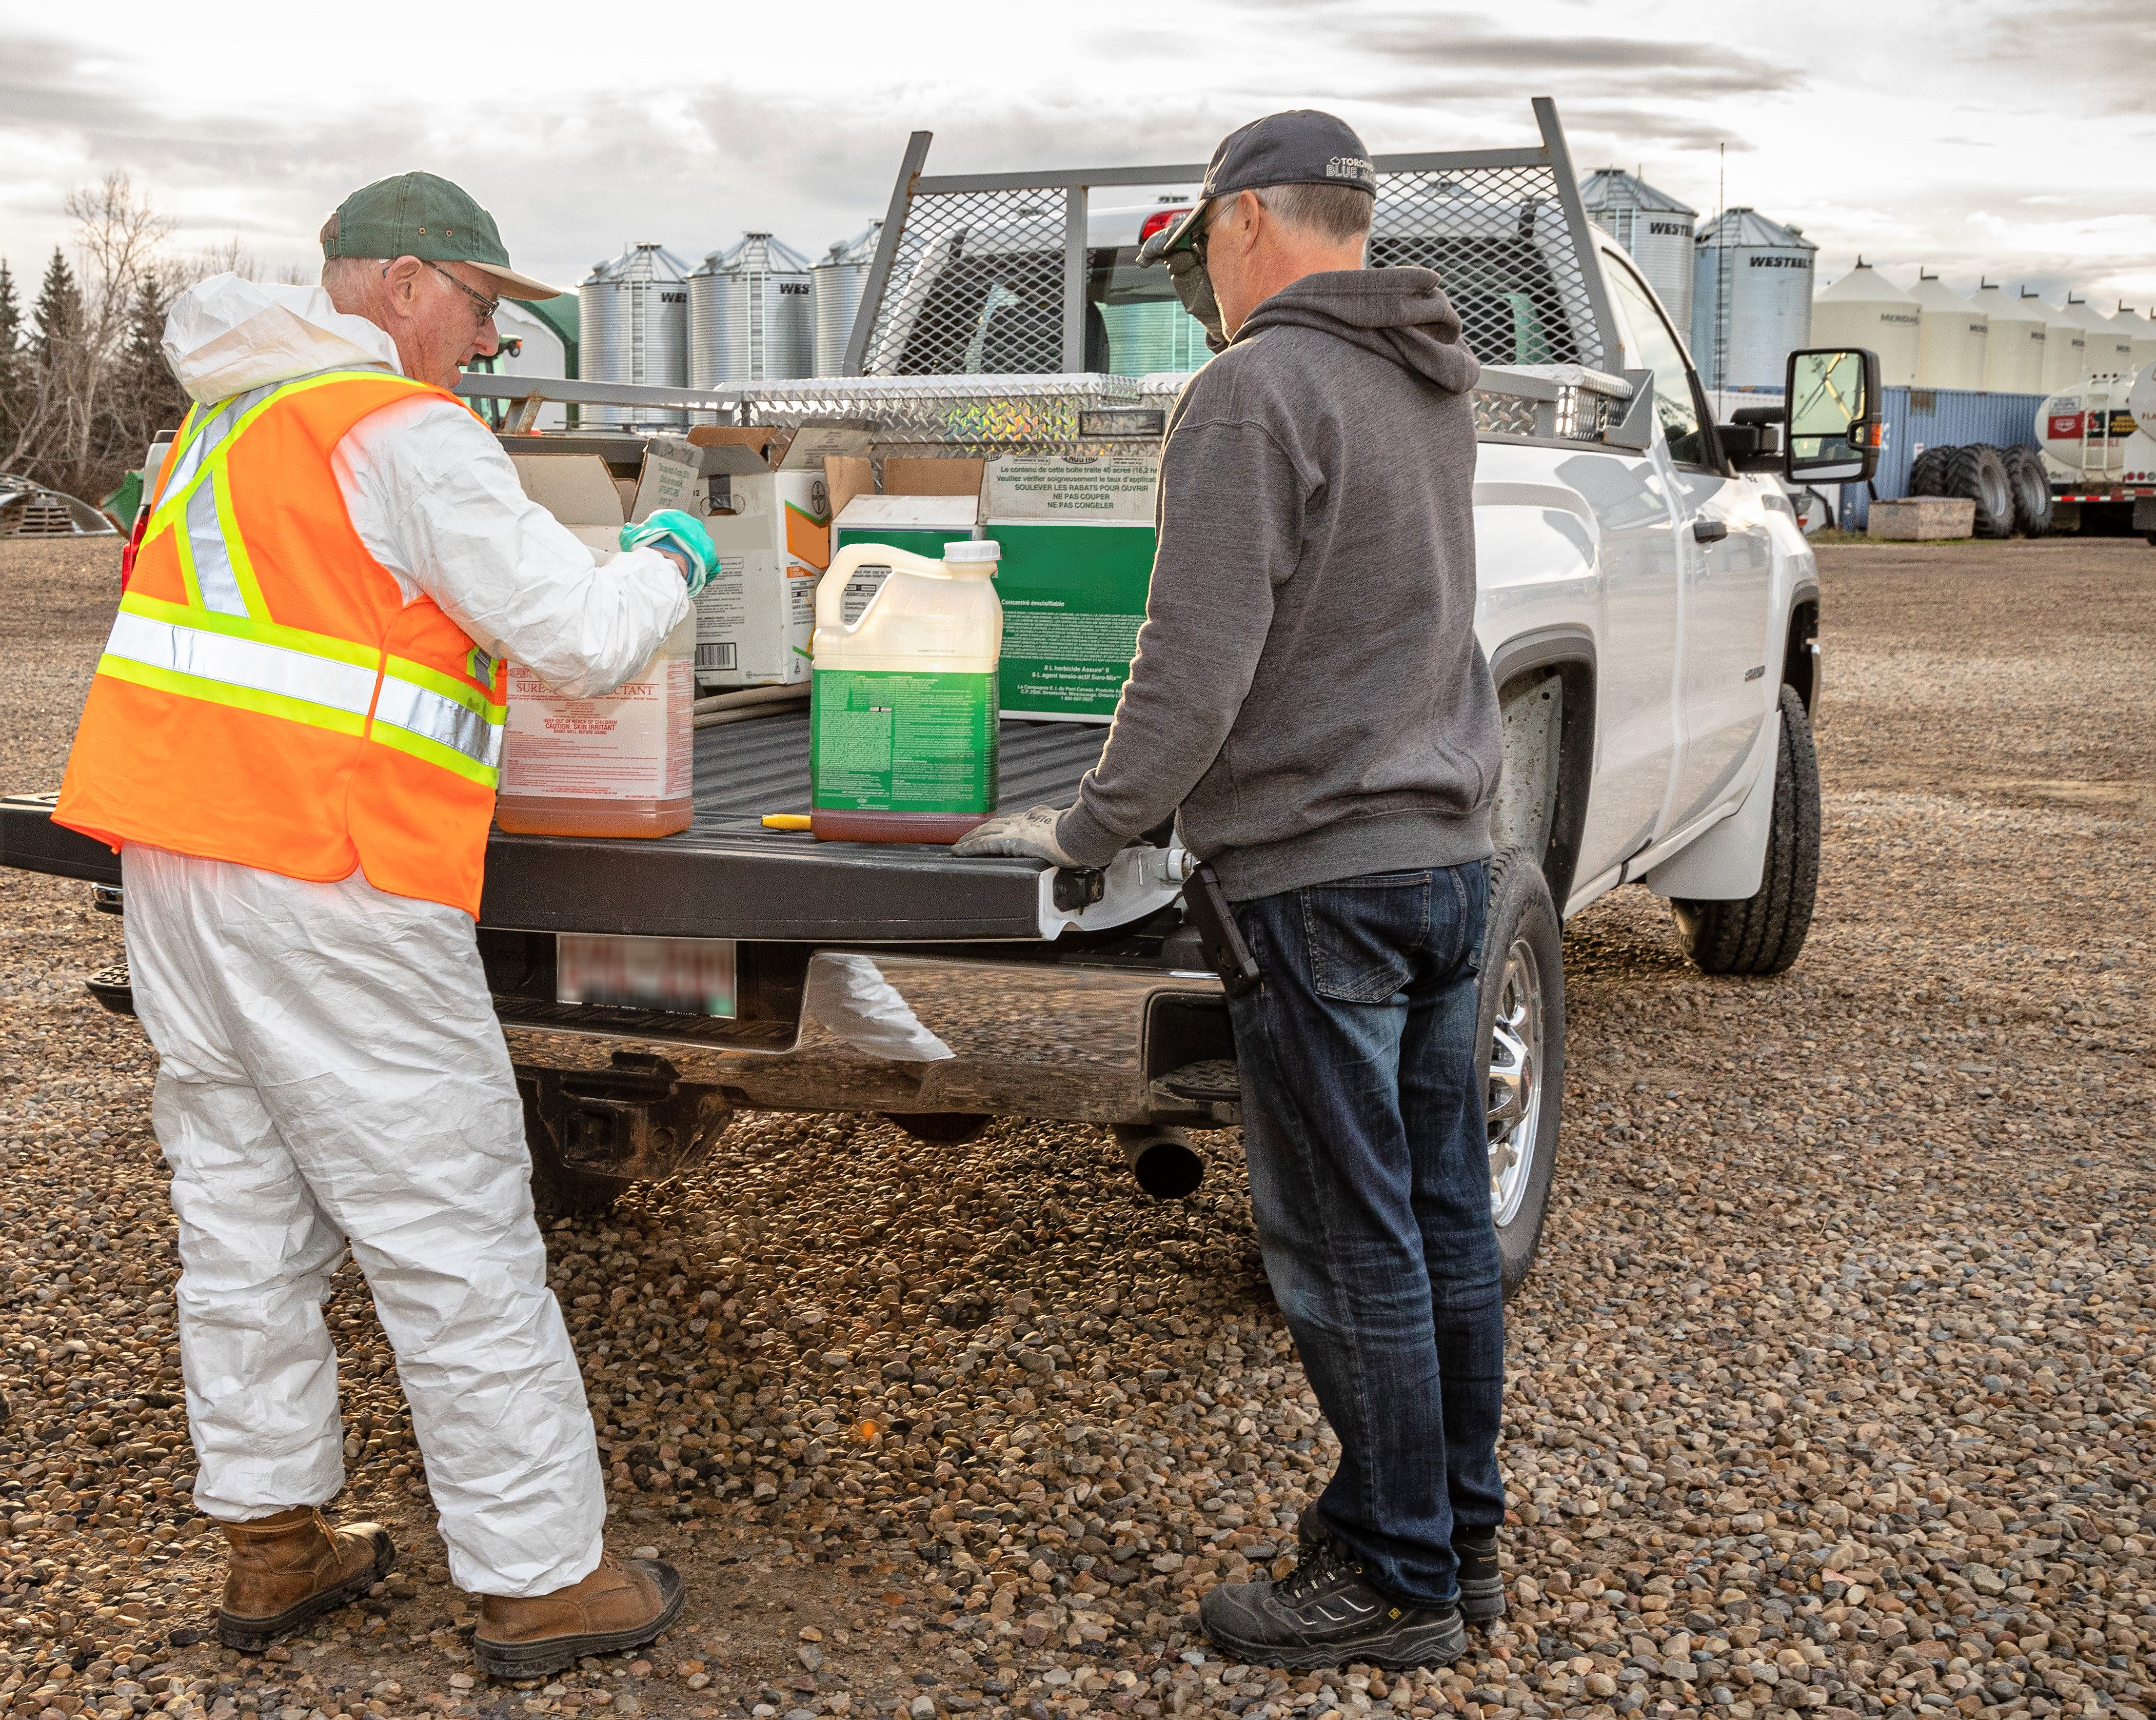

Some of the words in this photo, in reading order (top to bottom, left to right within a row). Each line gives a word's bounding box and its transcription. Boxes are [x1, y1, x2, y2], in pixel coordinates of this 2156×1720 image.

[1325, 164, 1358, 178] BLUE
[780, 284, 810, 294] WES
[1047, 475, 1097, 483] soigneusement
[517, 683, 546, 692] SURE
[613, 686, 654, 695] CTANT
